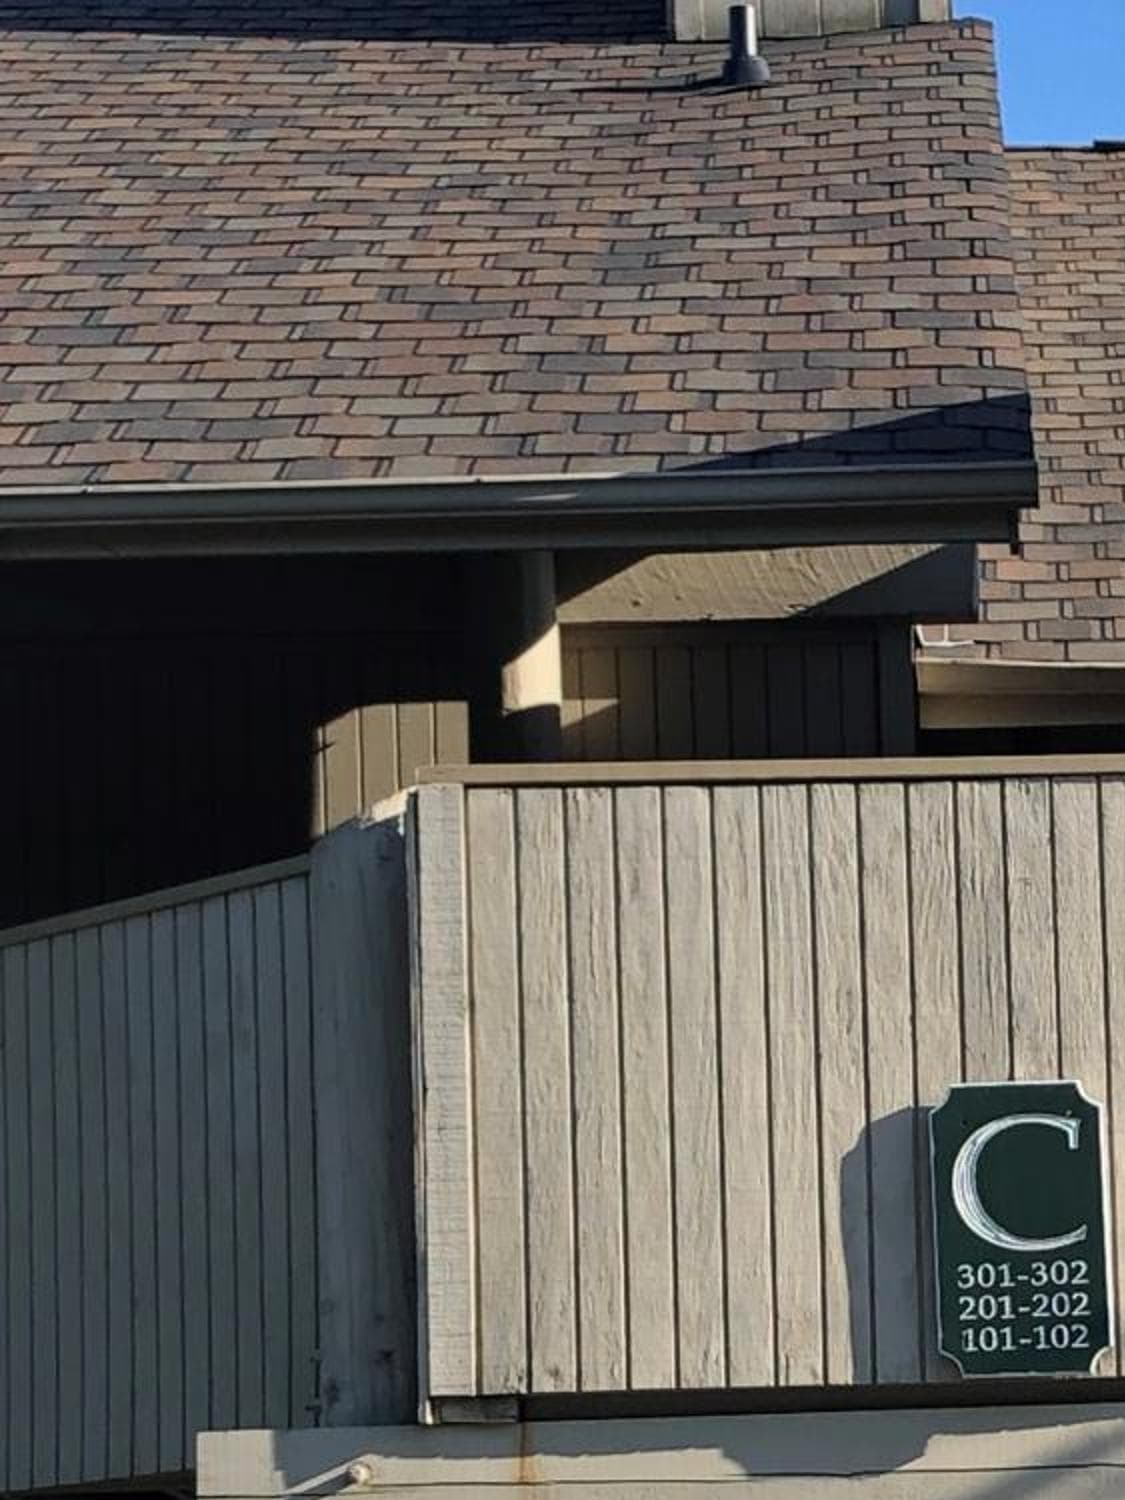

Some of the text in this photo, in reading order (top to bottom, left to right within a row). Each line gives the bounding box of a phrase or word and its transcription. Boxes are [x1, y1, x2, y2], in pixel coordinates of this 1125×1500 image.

[952, 1113, 1087, 1250] C
[957, 1260, 1089, 1288] 301-302
[959, 1292, 1091, 1320] 201-202
[962, 1324, 1090, 1352] 101-102
